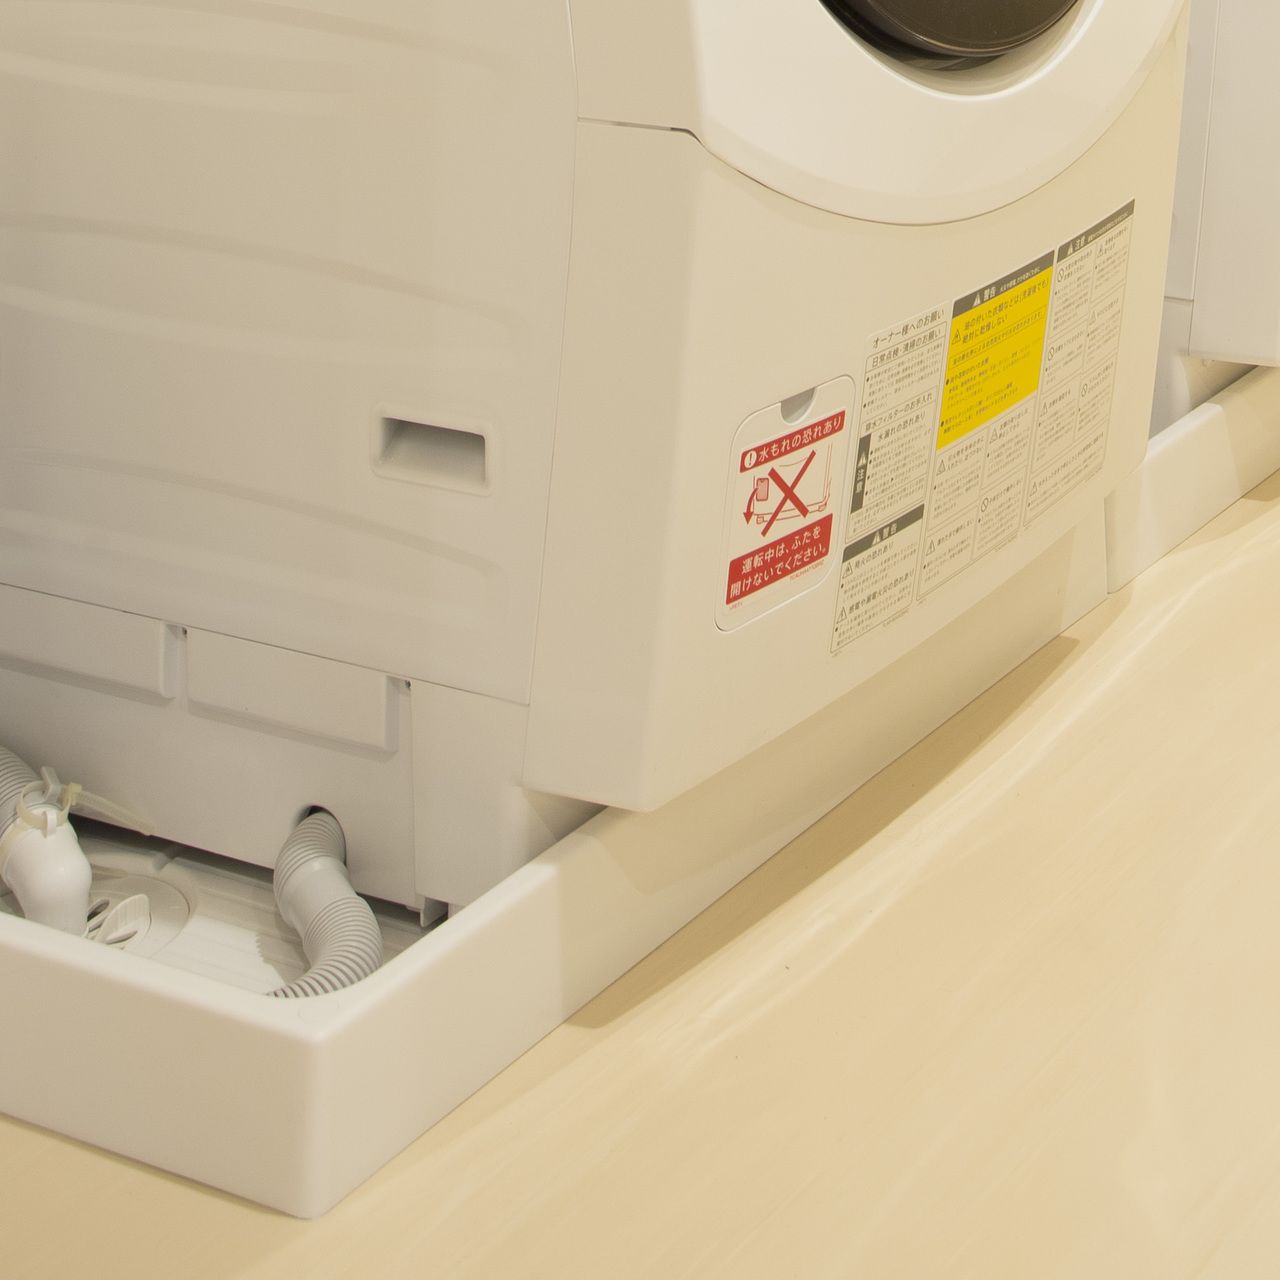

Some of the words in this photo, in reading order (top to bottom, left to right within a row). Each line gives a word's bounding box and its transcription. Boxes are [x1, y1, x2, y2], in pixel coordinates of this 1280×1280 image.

[873, 309, 944, 349] オーナー様へのお願い
[758, 415, 841, 462] 水もれの恐れあり
[730, 544, 827, 597] 開けないでください。
[742, 526, 822, 574] 運転中は、ふたを
